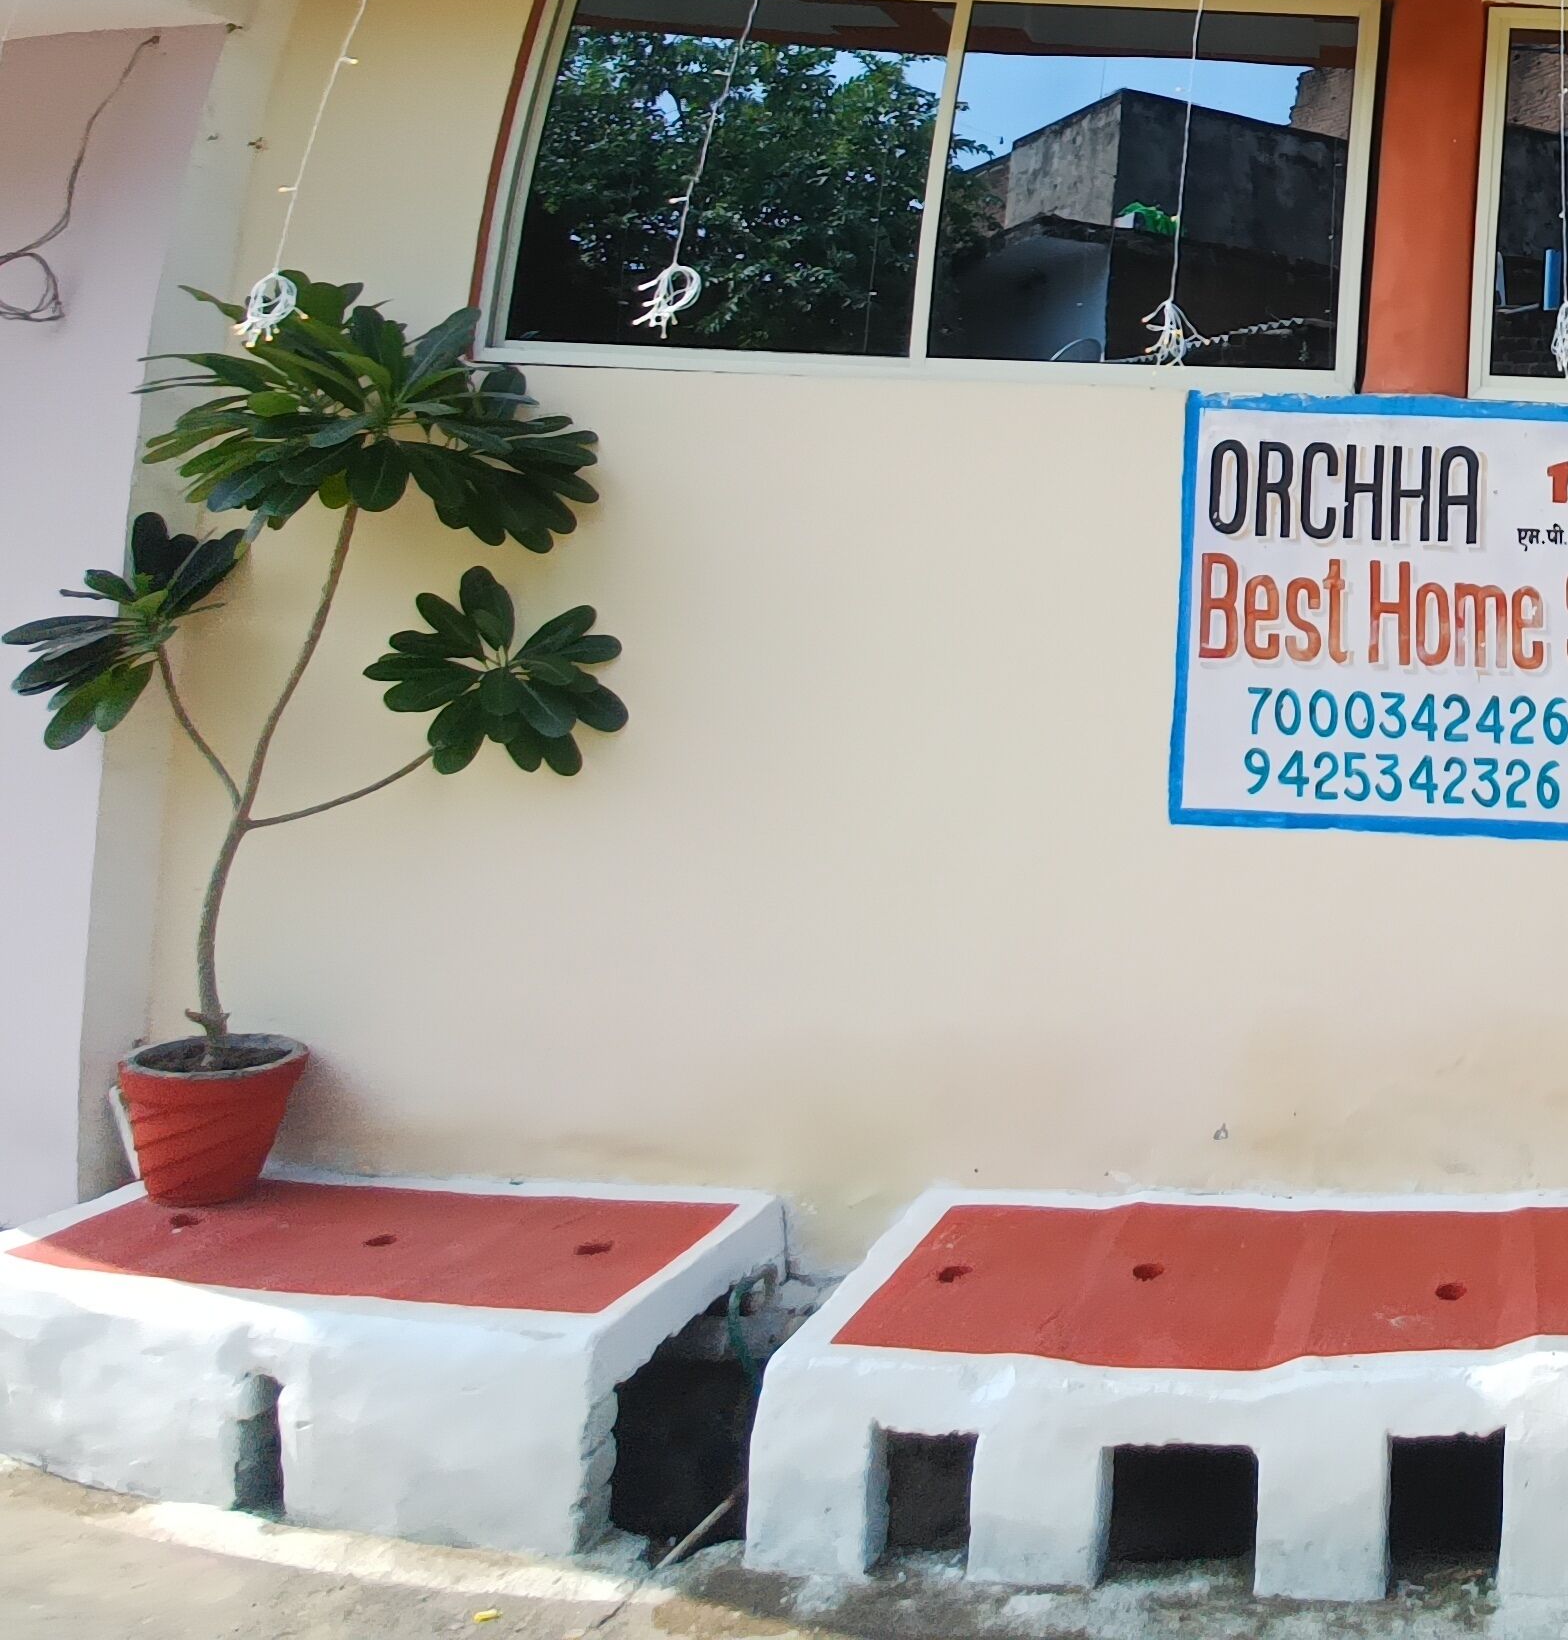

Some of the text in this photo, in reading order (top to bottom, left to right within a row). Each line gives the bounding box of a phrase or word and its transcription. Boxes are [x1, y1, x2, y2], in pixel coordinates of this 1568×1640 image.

[1208, 439, 1480, 545] ORCHHA
[1198, 552, 1347, 663] Best
[1368, 560, 1545, 670] Home
[1244, 747, 1561, 810] 9425342326
